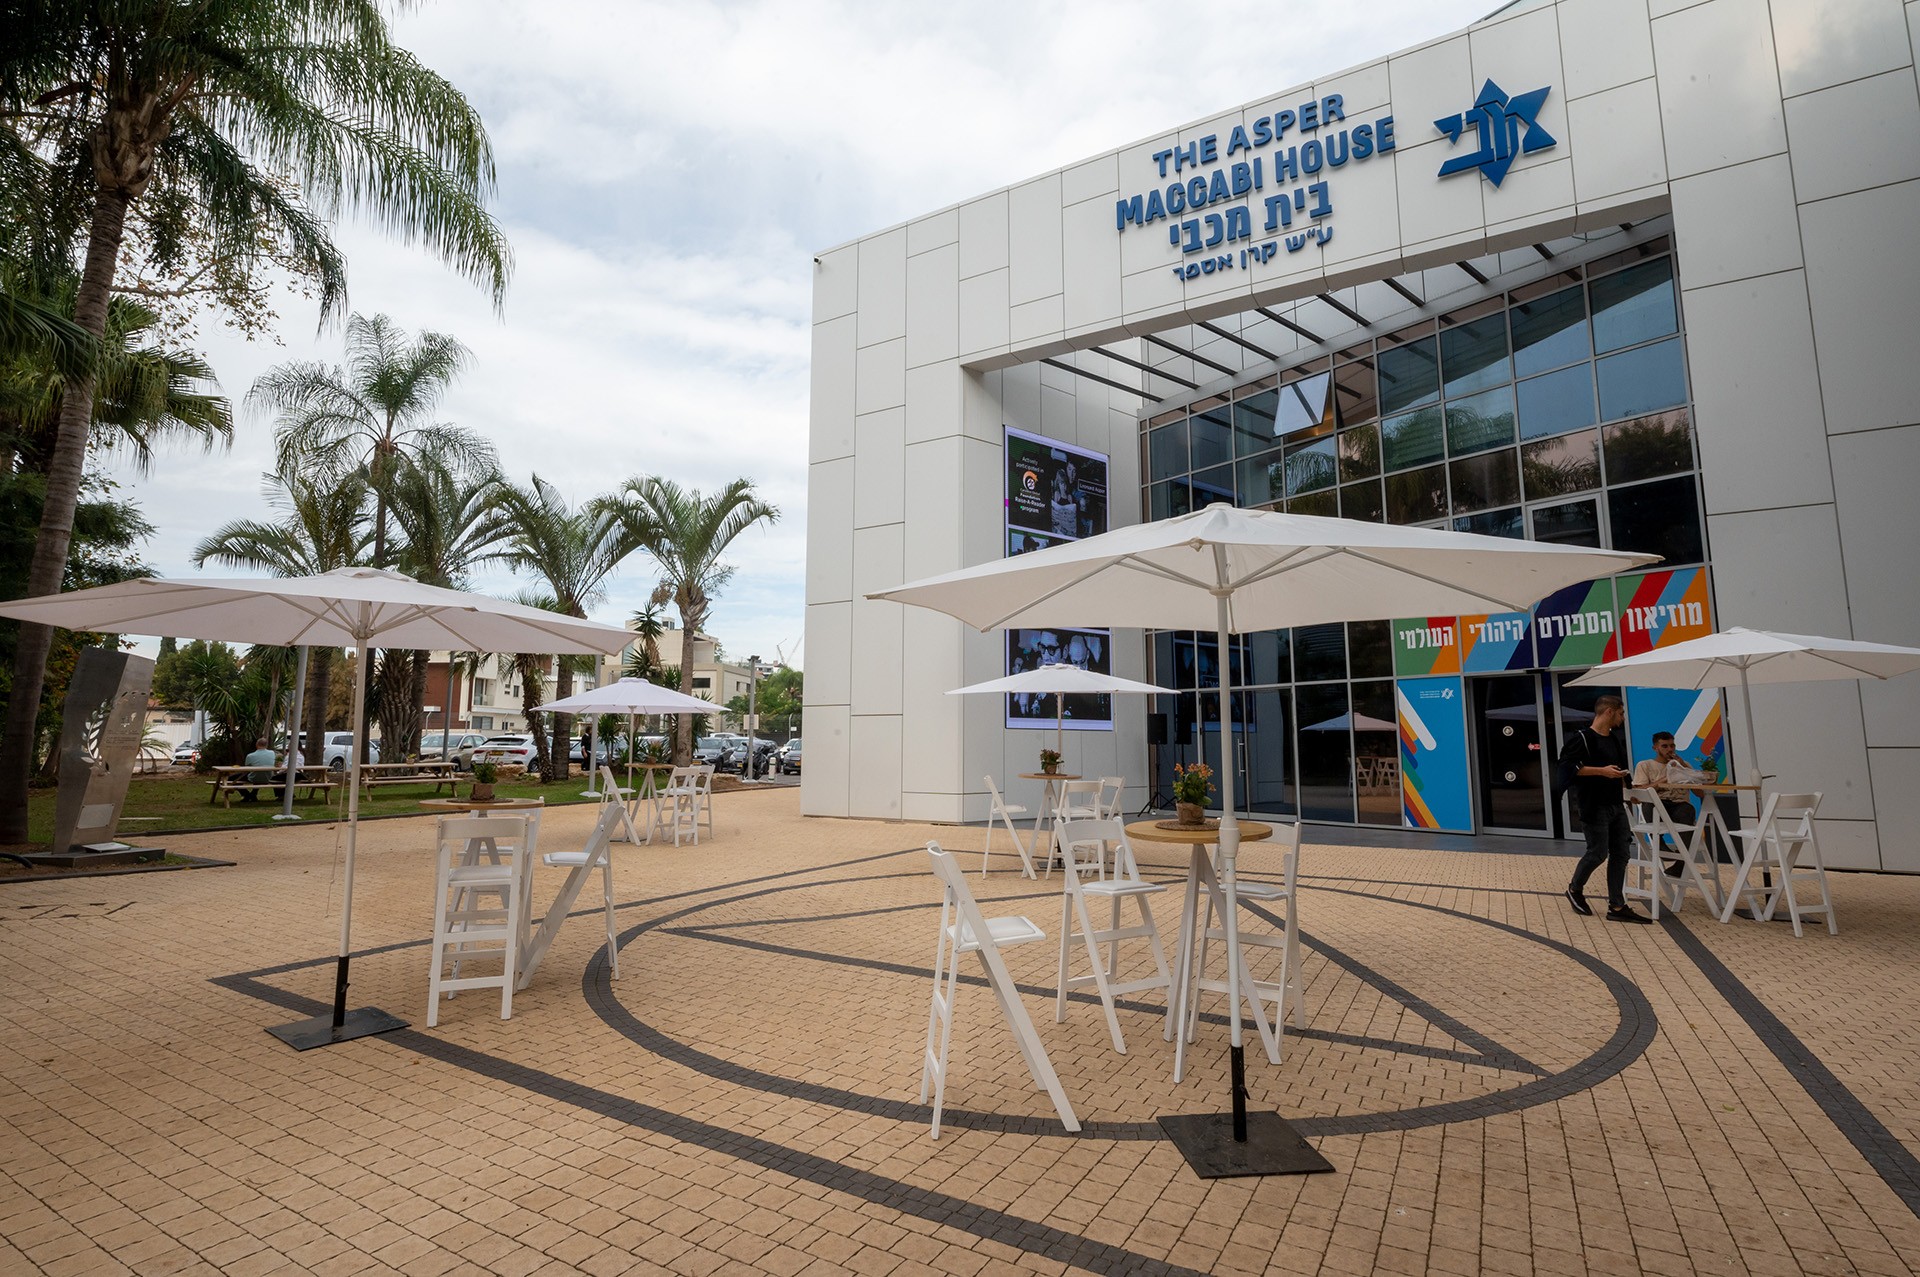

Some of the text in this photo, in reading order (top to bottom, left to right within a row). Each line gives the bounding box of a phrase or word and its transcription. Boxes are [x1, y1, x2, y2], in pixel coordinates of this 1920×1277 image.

[1152, 94, 1345, 178] THE ASPER
[1116, 115, 1396, 231] MACCABI HOUSE
[1169, 181, 1333, 254] בית מכבי
[1172, 253, 1233, 282] אספר
[1240, 241, 1278, 270] קרן
[1399, 601, 1703, 650] מוזיאון הספורט היהודי העולמי
